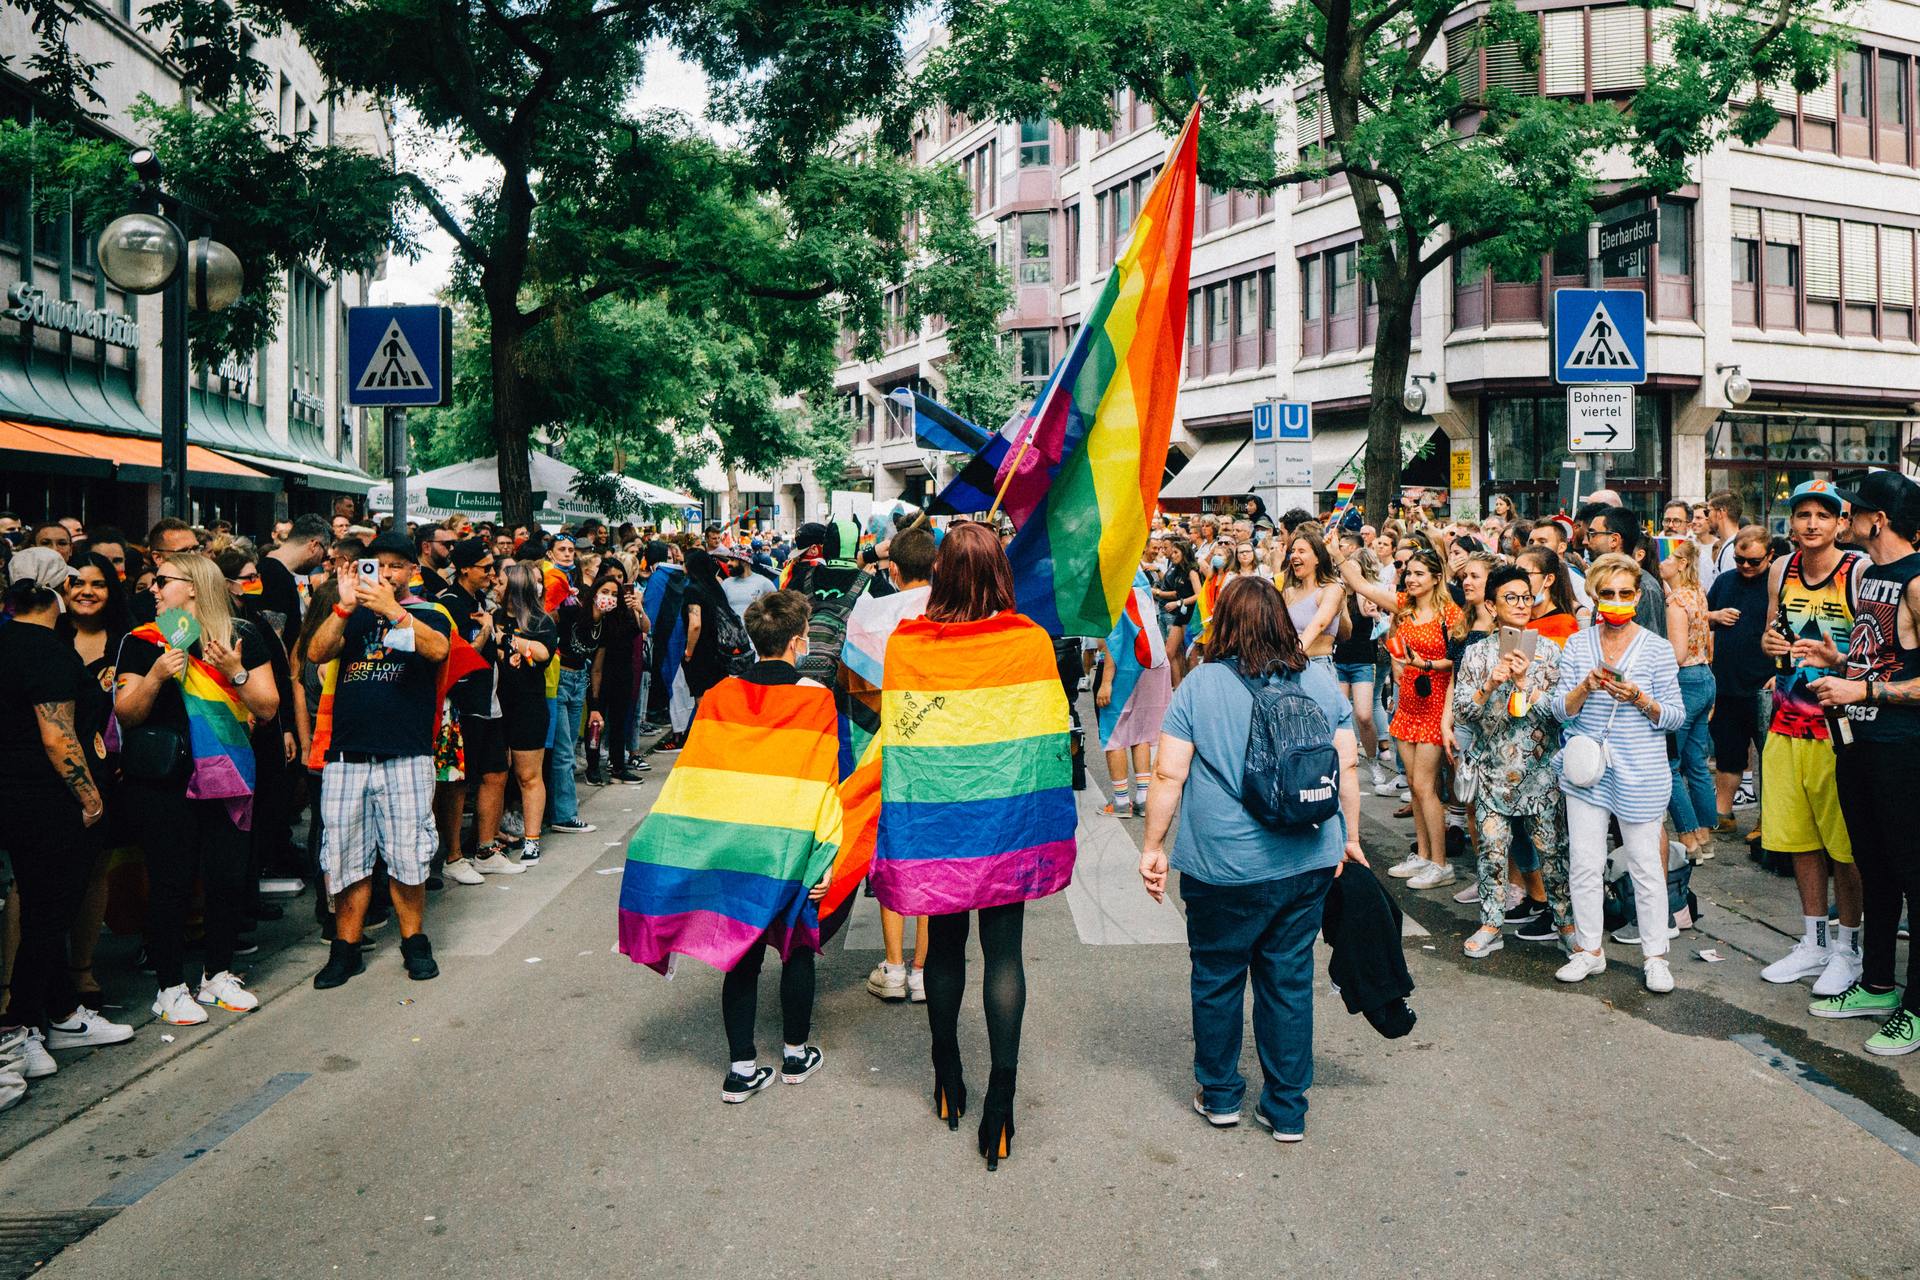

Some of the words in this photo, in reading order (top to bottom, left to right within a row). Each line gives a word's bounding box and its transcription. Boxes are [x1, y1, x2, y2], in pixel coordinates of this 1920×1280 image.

[1601, 221, 1653, 251] Eberhardstr.
[1574, 391, 1628, 403] Bohnen-
[1257, 407, 1269, 431] U
[1284, 406, 1303, 430] U
[1581, 406, 1622, 417] viertel
[376, 662, 406, 672] LOVE
[344, 670, 369, 683] LESS
[1299, 785, 1333, 803] PUMA
